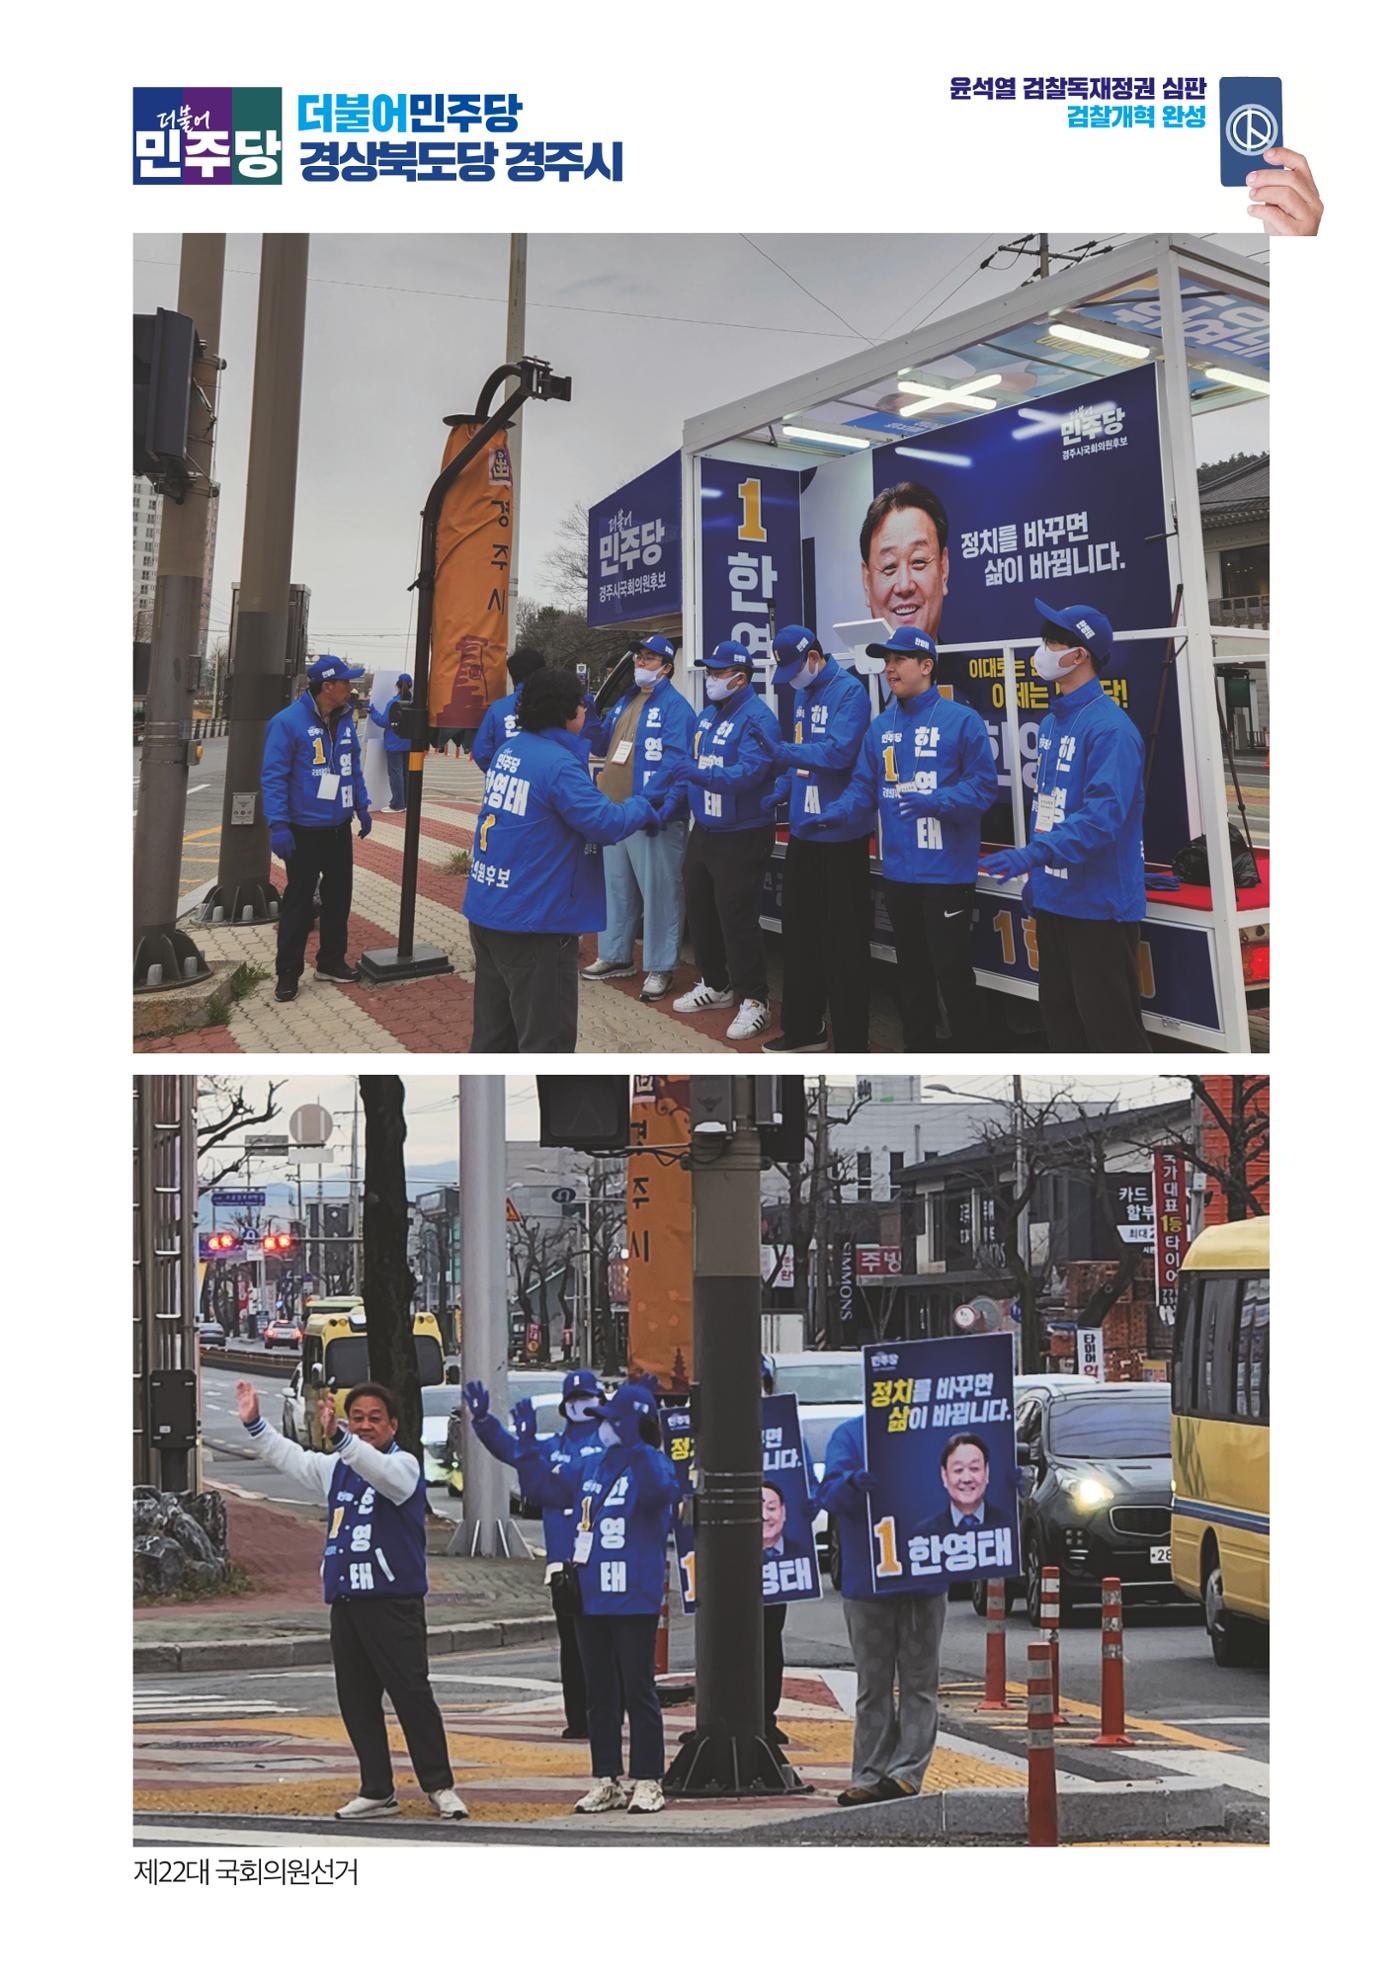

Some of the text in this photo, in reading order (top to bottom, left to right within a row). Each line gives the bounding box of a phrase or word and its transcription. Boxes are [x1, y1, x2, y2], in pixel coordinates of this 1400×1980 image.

[1060, 408, 1126, 446] 민주당
[738, 477, 768, 543] 1
[599, 518, 666, 577] 민주당
[961, 511, 1089, 560] 정치를 바꾸면
[984, 541, 1126, 587] 삶이 바뀝니다.
[599, 571, 667, 603] 경주시국회의원후보
[312, 737, 326, 765] 1
[883, 745, 899, 782] 1
[993, 909, 1017, 965] 1
[1118, 1186, 1149, 1202] 카드
[1159, 1214, 1183, 1233] 1등
[1164, 1236, 1181, 1283] 타이어
[870, 1373, 994, 1408] 정치를 바꾸면
[887, 1398, 1012, 1433] 삶이 바뀝니다.
[763, 1448, 802, 1471] 니다.
[873, 1515, 903, 1578] 1
[907, 1527, 1013, 1577] 한영태
